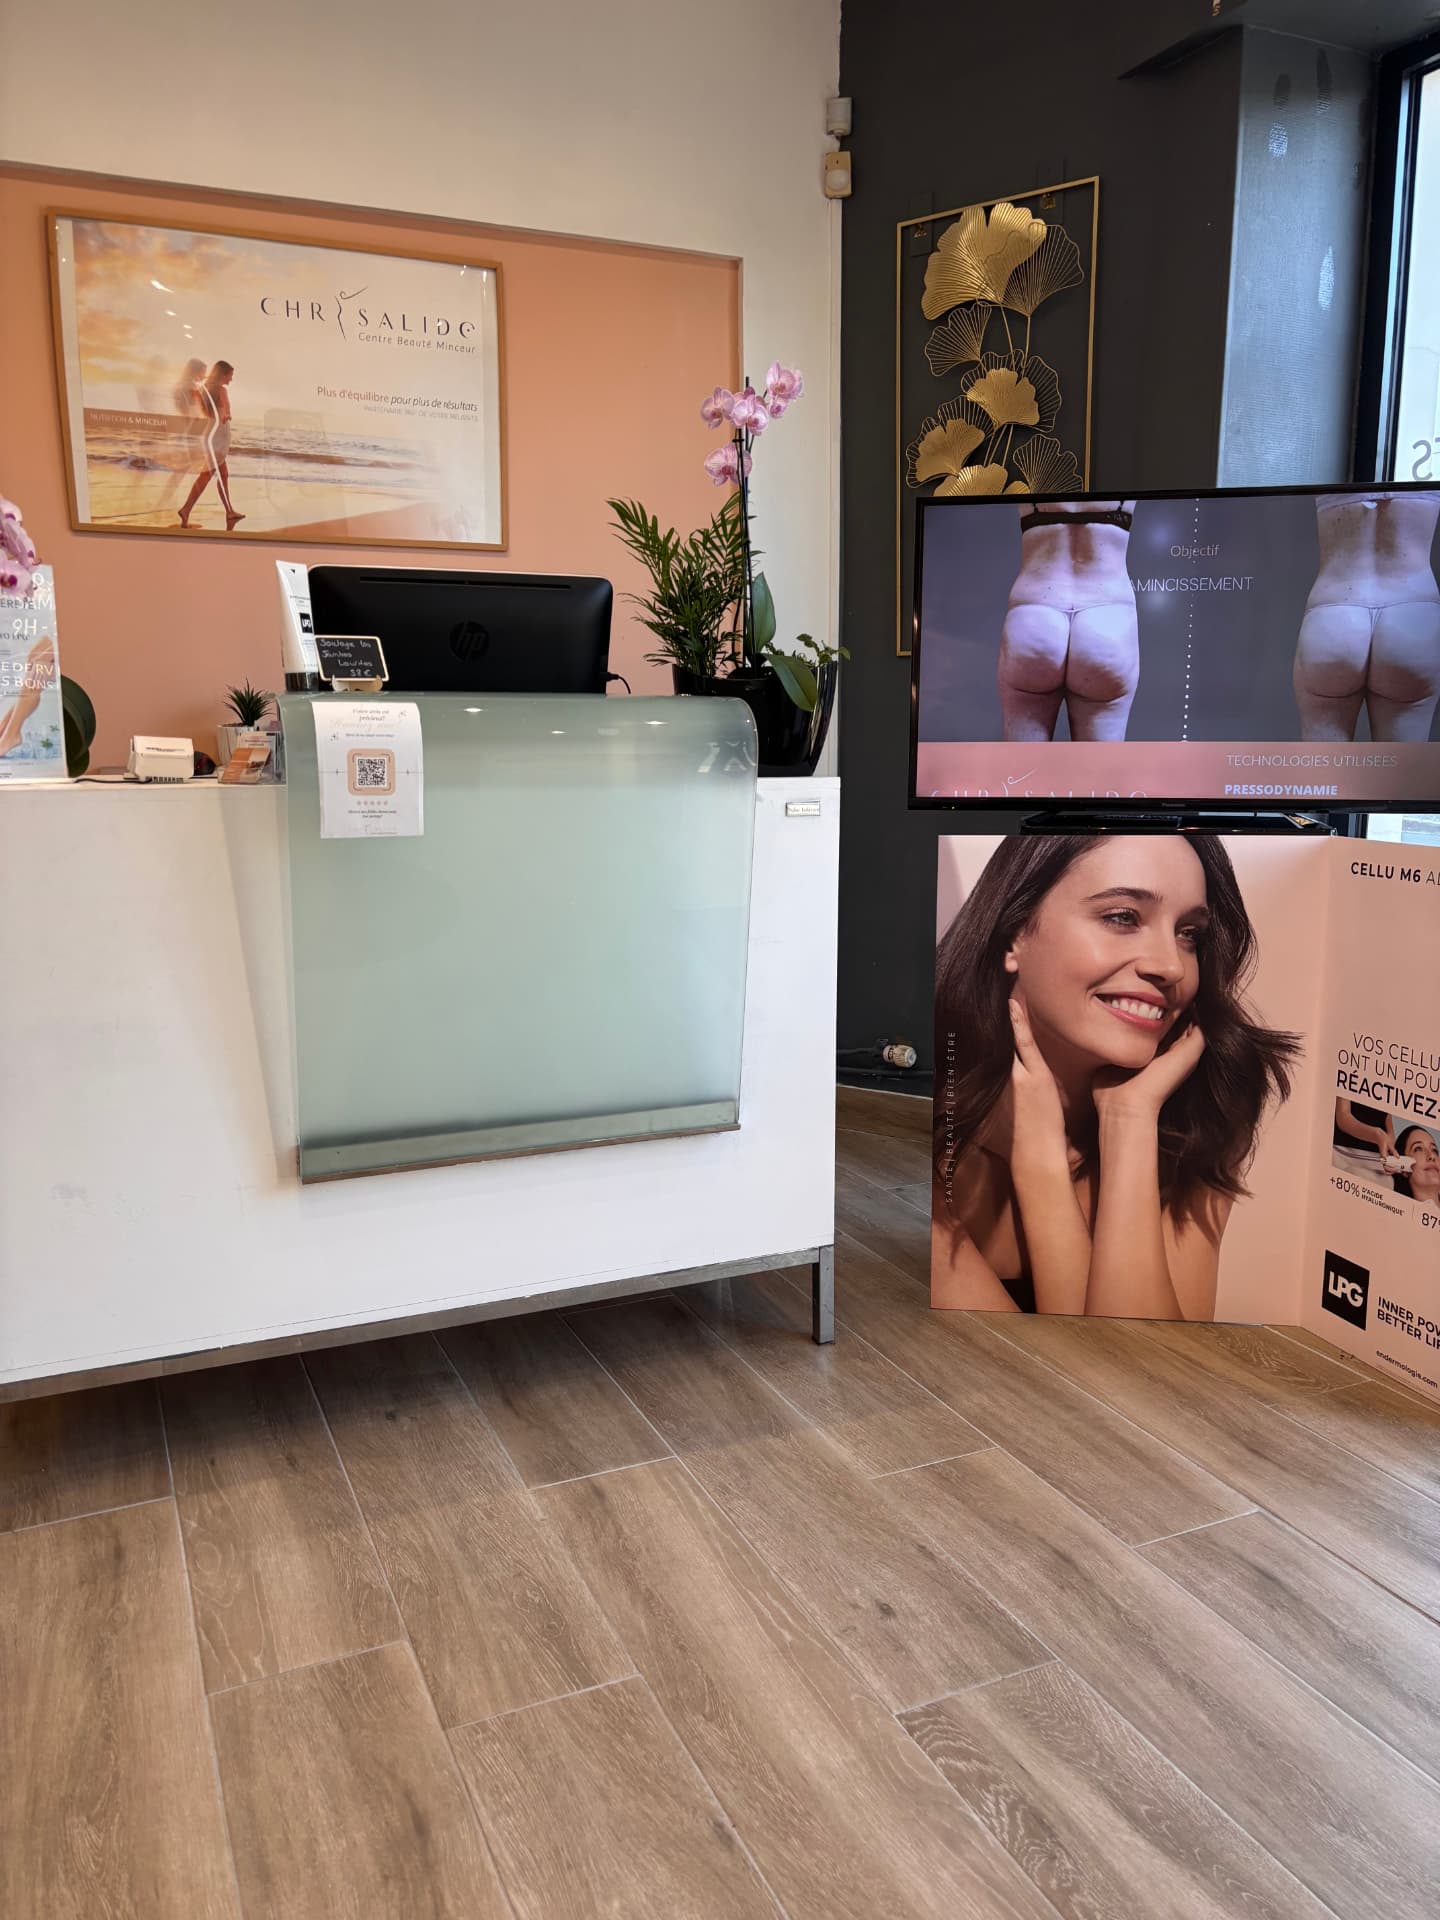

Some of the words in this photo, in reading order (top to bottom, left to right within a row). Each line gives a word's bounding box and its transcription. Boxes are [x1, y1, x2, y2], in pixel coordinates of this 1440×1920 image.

[358, 332, 392, 345] Centre
[397, 336, 431, 349] Beauté
[436, 341, 476, 353] Minceur
[317, 386, 337, 398] Plus
[339, 389, 389, 403] d'équilibre
[390, 395, 411, 406] pour
[412, 397, 430, 408] plus
[431, 399, 442, 408] de
[443, 400, 478, 412] résultats
[1170, 544, 1220, 559] Objectif
[1226, 754, 1329, 767] TECHNOLOGIES
[1224, 784, 1338, 796] PRESSODYNAMIE
[1351, 861, 1395, 879] CELLU
[1400, 867, 1421, 883] M6
[1353, 1032, 1384, 1055] VOS
[1388, 1043, 1440, 1072] CELLU
[1338, 1049, 1370, 1072] ONT
[1375, 1059, 1398, 1081] UN
[1404, 1068, 1440, 1093] POU
[1330, 1176, 1360, 1198] +80%
[1361, 1187, 1384, 1201] D'ACIDE
[1327, 1271, 1364, 1308] LPG
[1378, 1296, 1414, 1323] INNER
[1377, 1308, 1422, 1341] BETTER
[1375, 1350, 1438, 1389] endermologie.com
